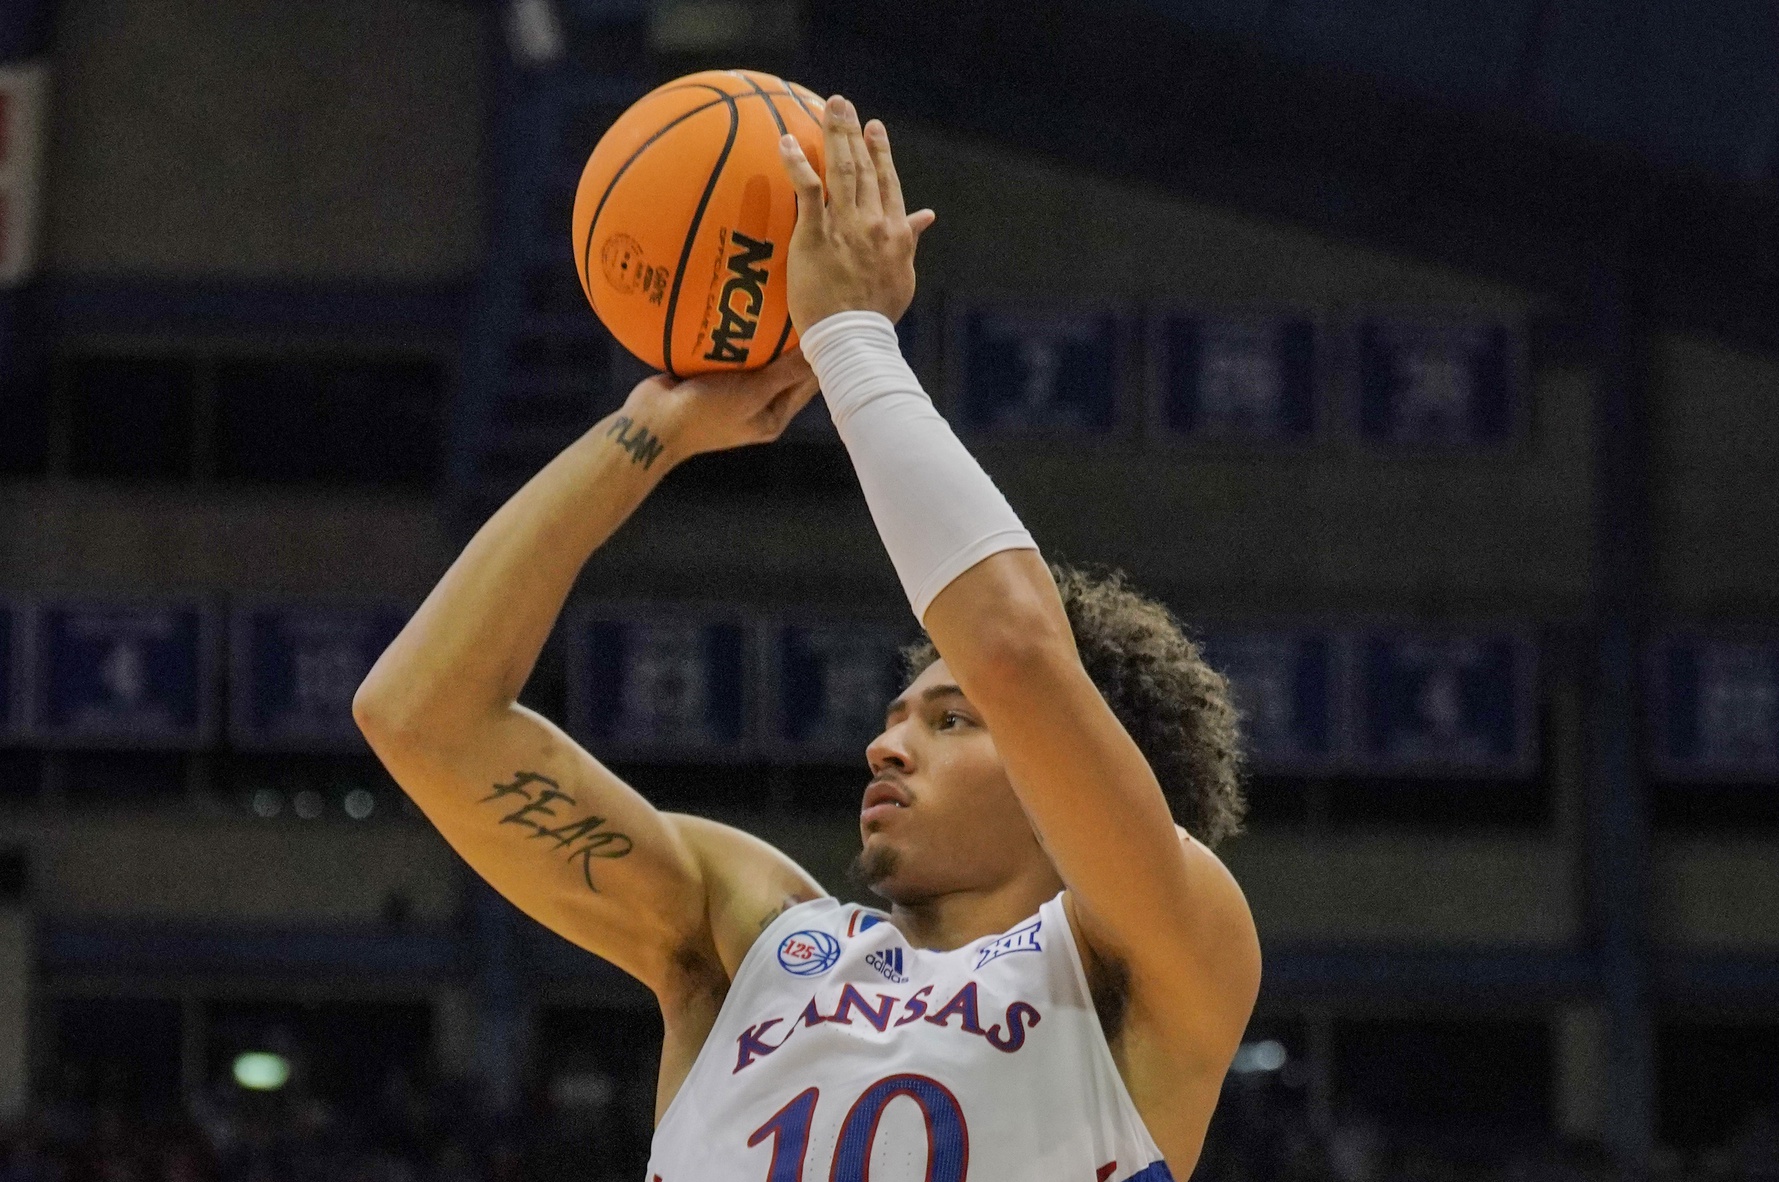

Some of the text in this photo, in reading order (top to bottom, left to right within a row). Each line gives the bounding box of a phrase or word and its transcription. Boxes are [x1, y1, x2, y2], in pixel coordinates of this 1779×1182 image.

[703, 230, 775, 363] NCAA
[477, 769, 634, 893] FEAR
[782, 939, 815, 961] 125
[865, 953, 909, 984] adidas
[732, 981, 1042, 1075] KANSAS
